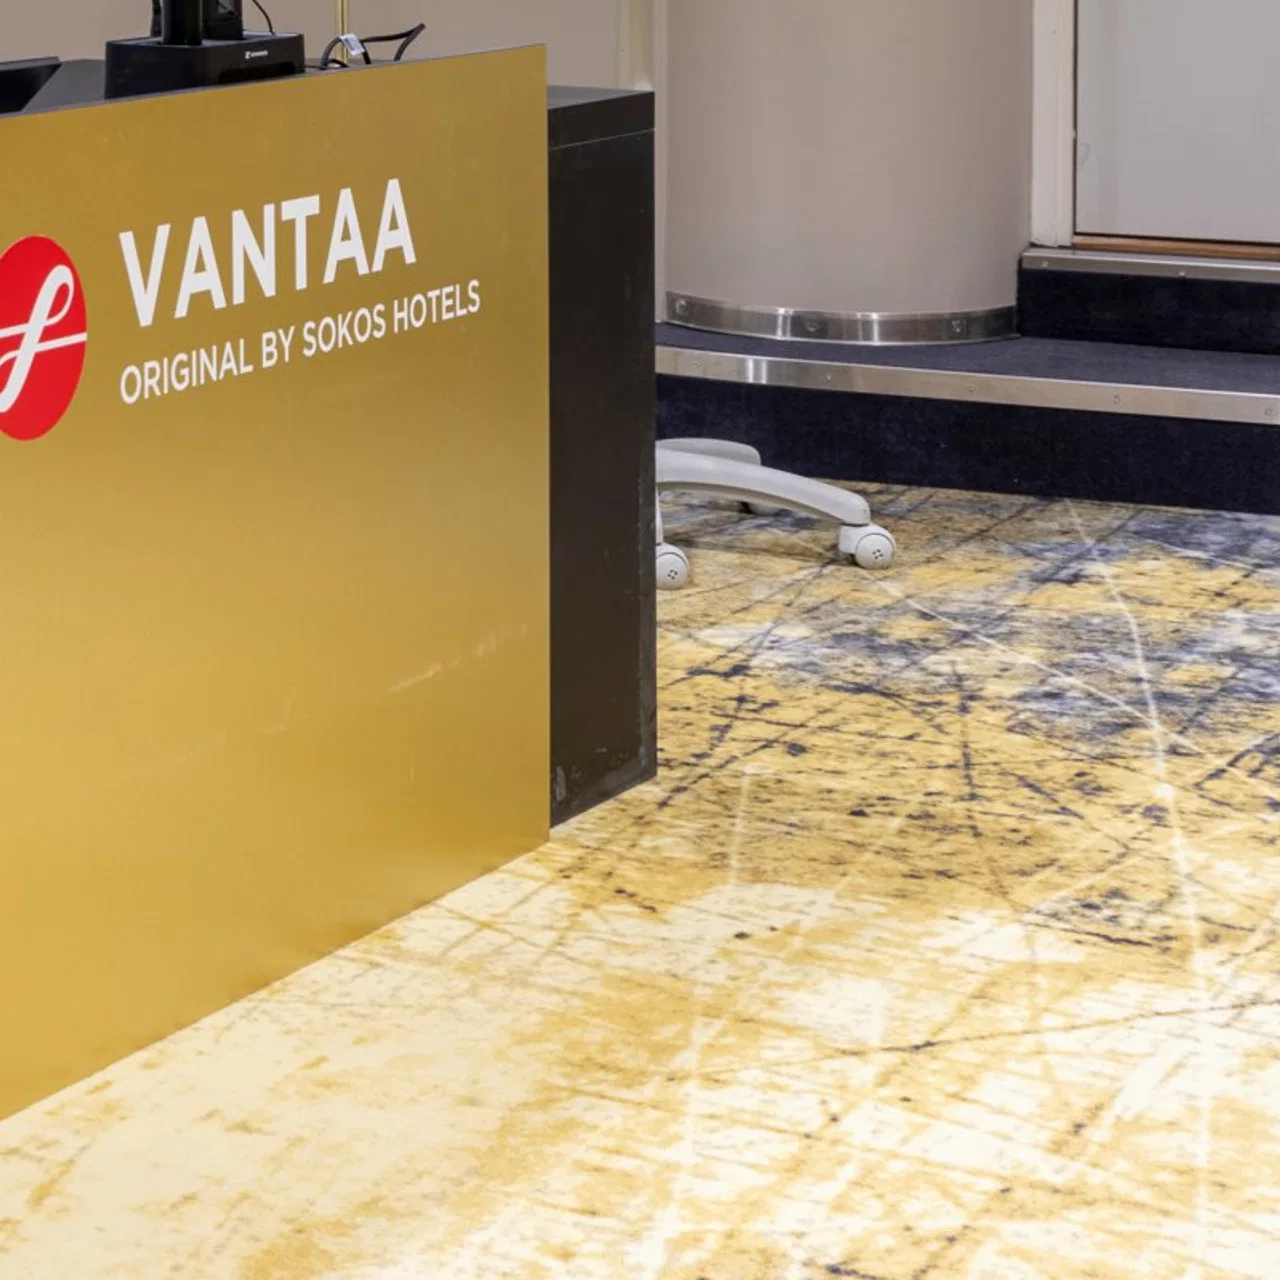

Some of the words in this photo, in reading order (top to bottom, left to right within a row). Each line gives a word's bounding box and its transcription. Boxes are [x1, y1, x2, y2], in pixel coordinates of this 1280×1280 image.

[119, 178, 417, 327] VANTAA
[120, 338, 254, 405] ORIGINAL
[262, 325, 295, 368] BY
[302, 303, 386, 357] SOKOS
[393, 279, 481, 334] HOTELS
